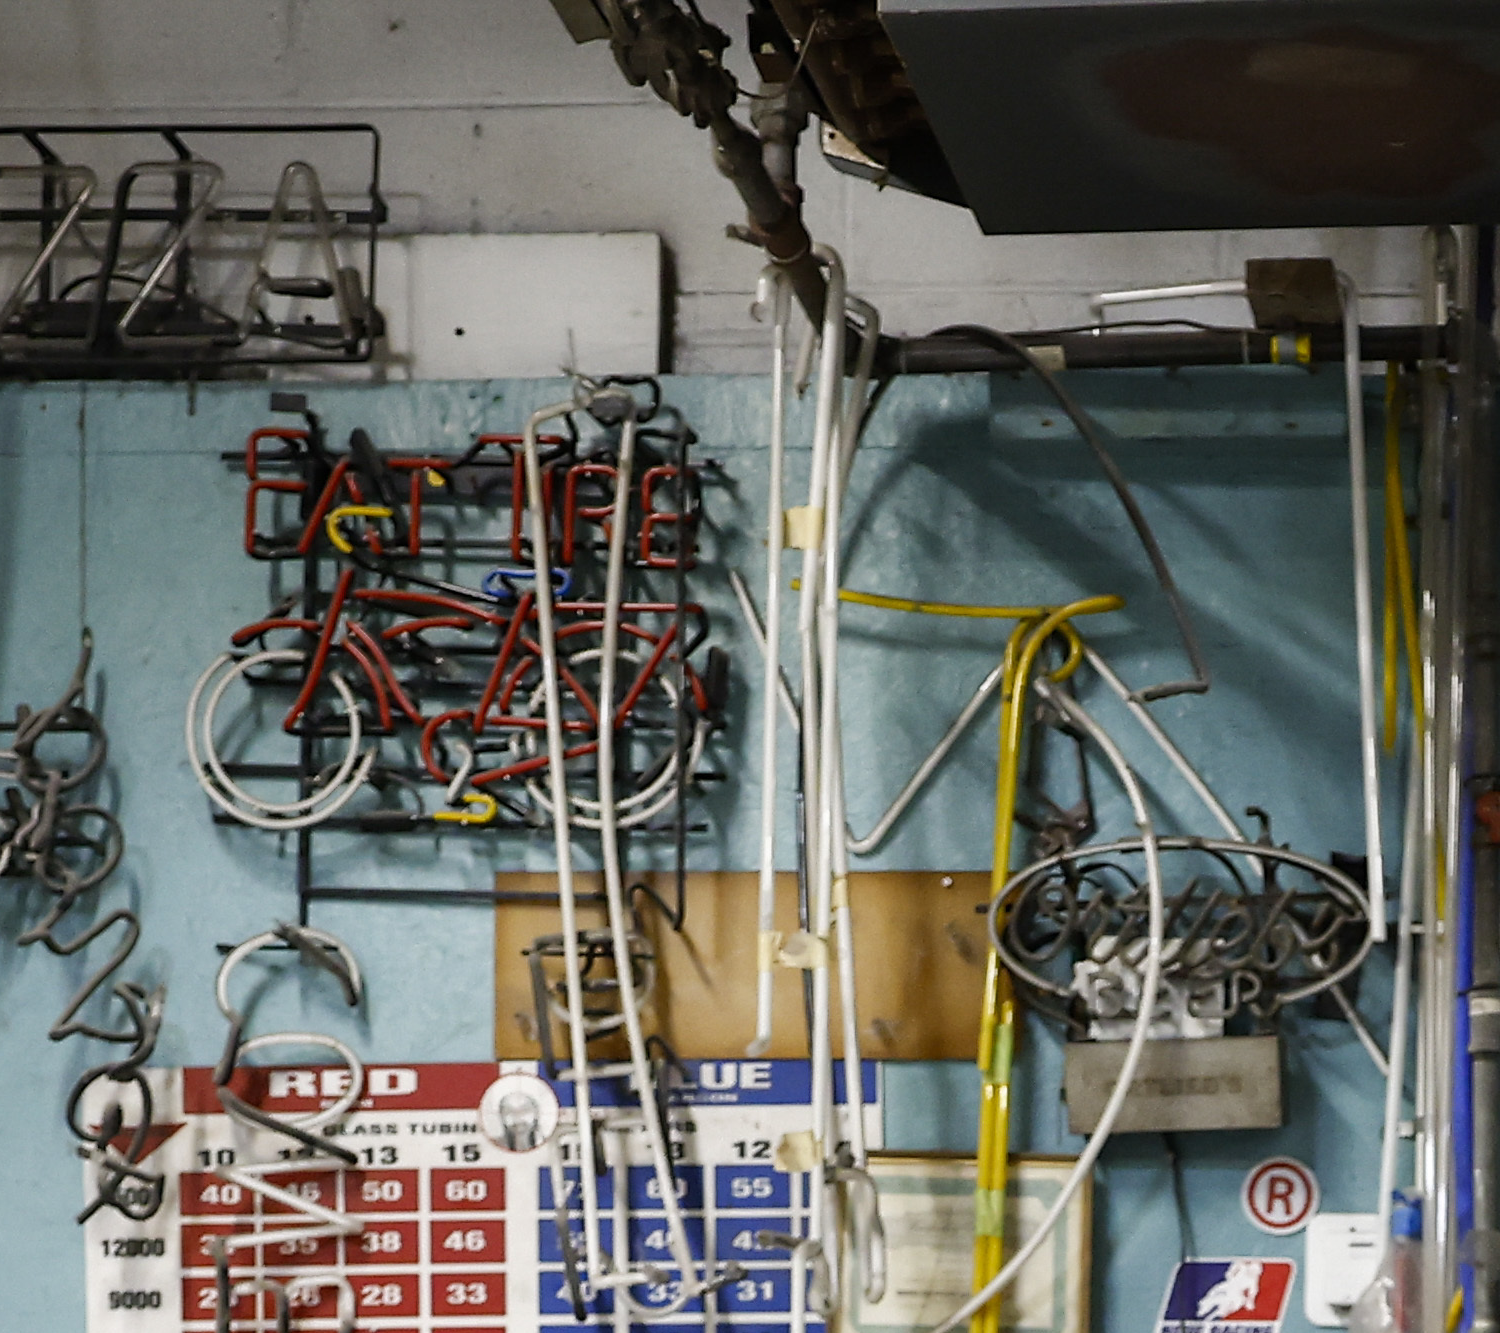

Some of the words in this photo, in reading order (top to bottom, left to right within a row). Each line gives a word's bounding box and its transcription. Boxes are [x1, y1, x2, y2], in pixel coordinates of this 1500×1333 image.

[267, 1068, 419, 1099] RED
[408, 1122, 479, 1135] TUBIN
[198, 1148, 236, 1167] 10
[360, 1146, 399, 1166] 13
[441, 1144, 481, 1163] 15
[732, 1140, 773, 1160] 12
[200, 1185, 241, 1205] 40
[361, 1180, 403, 1202] 50
[444, 1179, 488, 1202] 60
[730, 1176, 774, 1198] 55
[360, 1231, 402, 1253] 38
[443, 1230, 486, 1252] 46
[108, 1291, 163, 1310] 9000
[360, 1284, 403, 1308] 28
[445, 1282, 489, 1305] 33
[736, 1279, 774, 1302] 31
